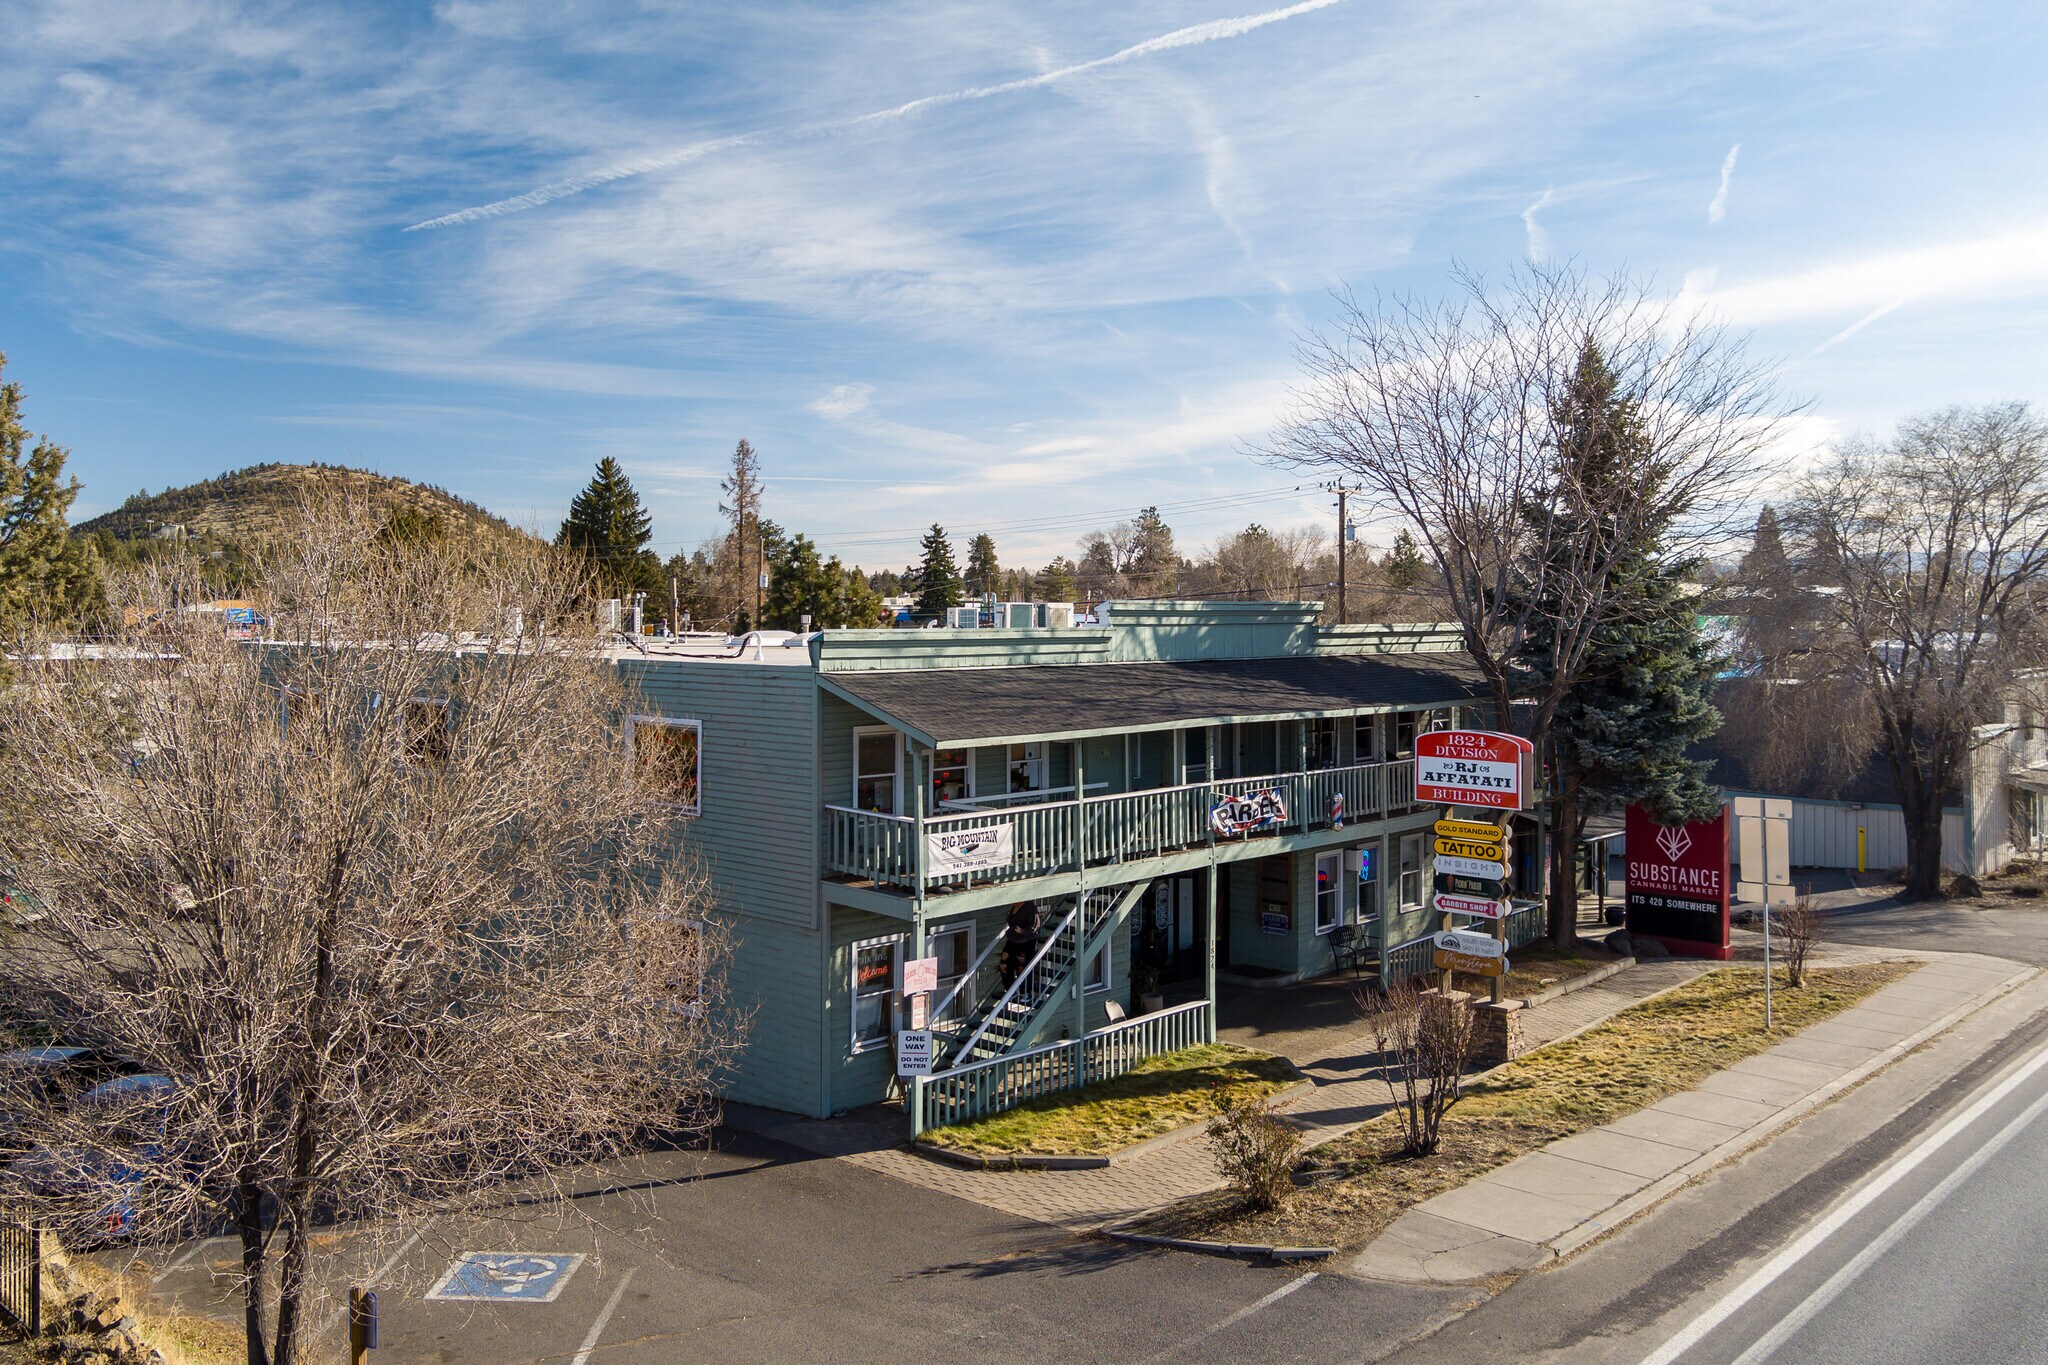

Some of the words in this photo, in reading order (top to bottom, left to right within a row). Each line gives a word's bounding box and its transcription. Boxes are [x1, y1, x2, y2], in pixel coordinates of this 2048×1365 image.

[1448, 734, 1486, 747] 1824
[1435, 745, 1498, 759] DIVISION
[1455, 762, 1478, 773] RJ
[1423, 771, 1512, 788] AFFATATI
[1433, 788, 1501, 804] BUILDING
[1437, 824, 1458, 832] GOLD
[1458, 827, 1499, 837] STANDARD
[941, 835, 956, 851] BIG
[957, 829, 998, 847] MOUNTAIN
[1440, 841, 1496, 858] TATTOO
[1438, 858, 1498, 872] INSIGHT
[1630, 861, 1720, 888] SUBSTANCE
[1630, 880, 1677, 891] CANNABIS
[1682, 886, 1720, 896] MARKET
[1441, 899, 1468, 909] BARBER
[1469, 903, 1488, 912] SHOP
[1631, 895, 1645, 905] ITS
[1649, 897, 1663, 907] 420
[1666, 899, 1718, 914] SOMEWHERE
[857, 955, 872, 965] alk
